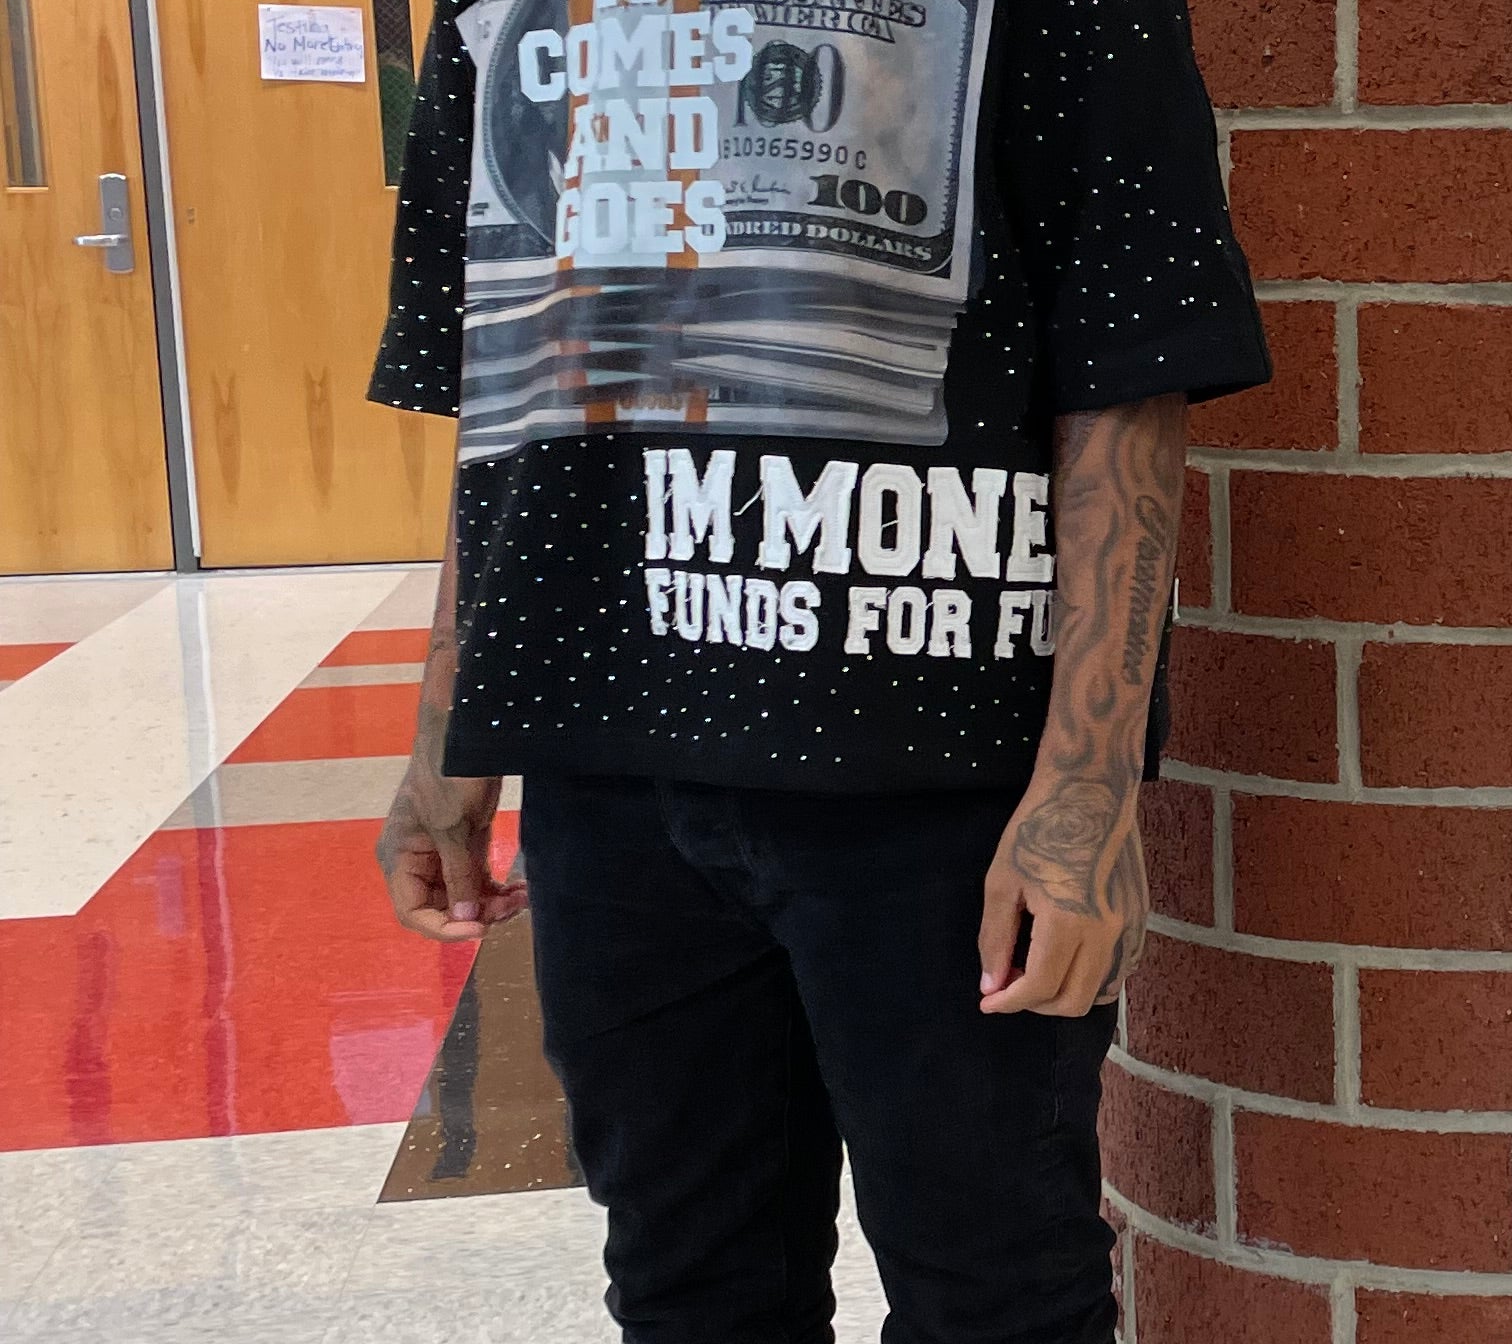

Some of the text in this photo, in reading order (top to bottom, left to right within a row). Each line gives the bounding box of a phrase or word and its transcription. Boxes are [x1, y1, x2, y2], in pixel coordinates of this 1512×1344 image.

[518, 7, 754, 102] COMES
[564, 96, 718, 179] AND
[555, 180, 726, 256] GOES
[806, 173, 929, 227] 100
[805, 223, 932, 262] DOLLARS
[643, 448, 737, 563] IM
[643, 566, 821, 652] FUNDS
[843, 585, 972, 659] FOR
